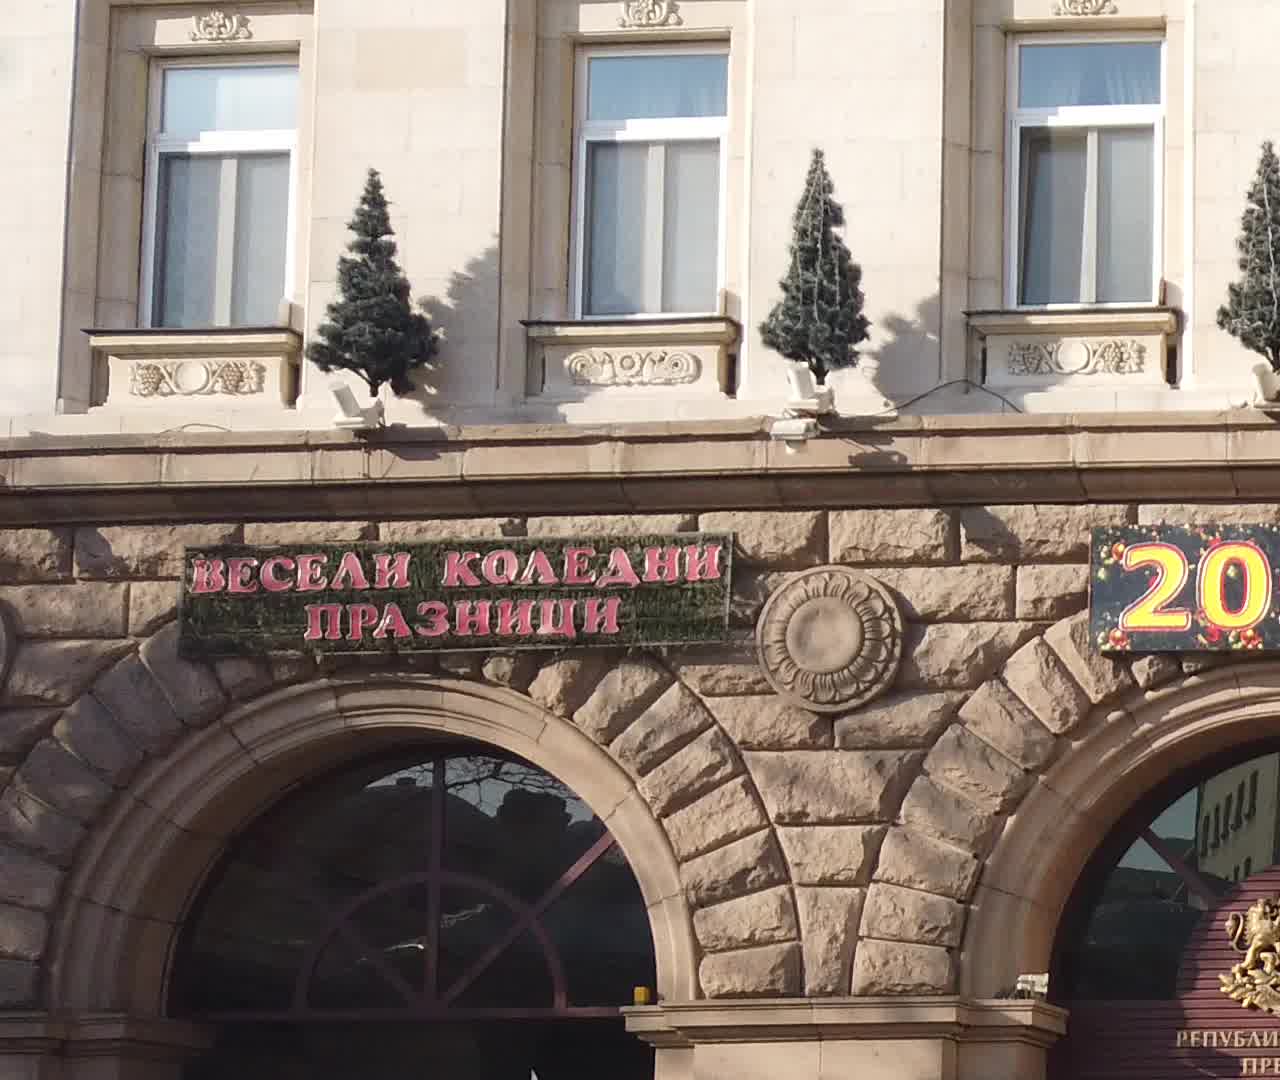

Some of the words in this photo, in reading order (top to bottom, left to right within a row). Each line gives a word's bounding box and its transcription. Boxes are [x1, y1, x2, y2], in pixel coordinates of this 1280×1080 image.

[189, 552, 412, 594] ВЕСЕЛИ
[441, 544, 723, 589] КОЛЕДНИ
[303, 597, 623, 641] ПРАЗНИЦИ
